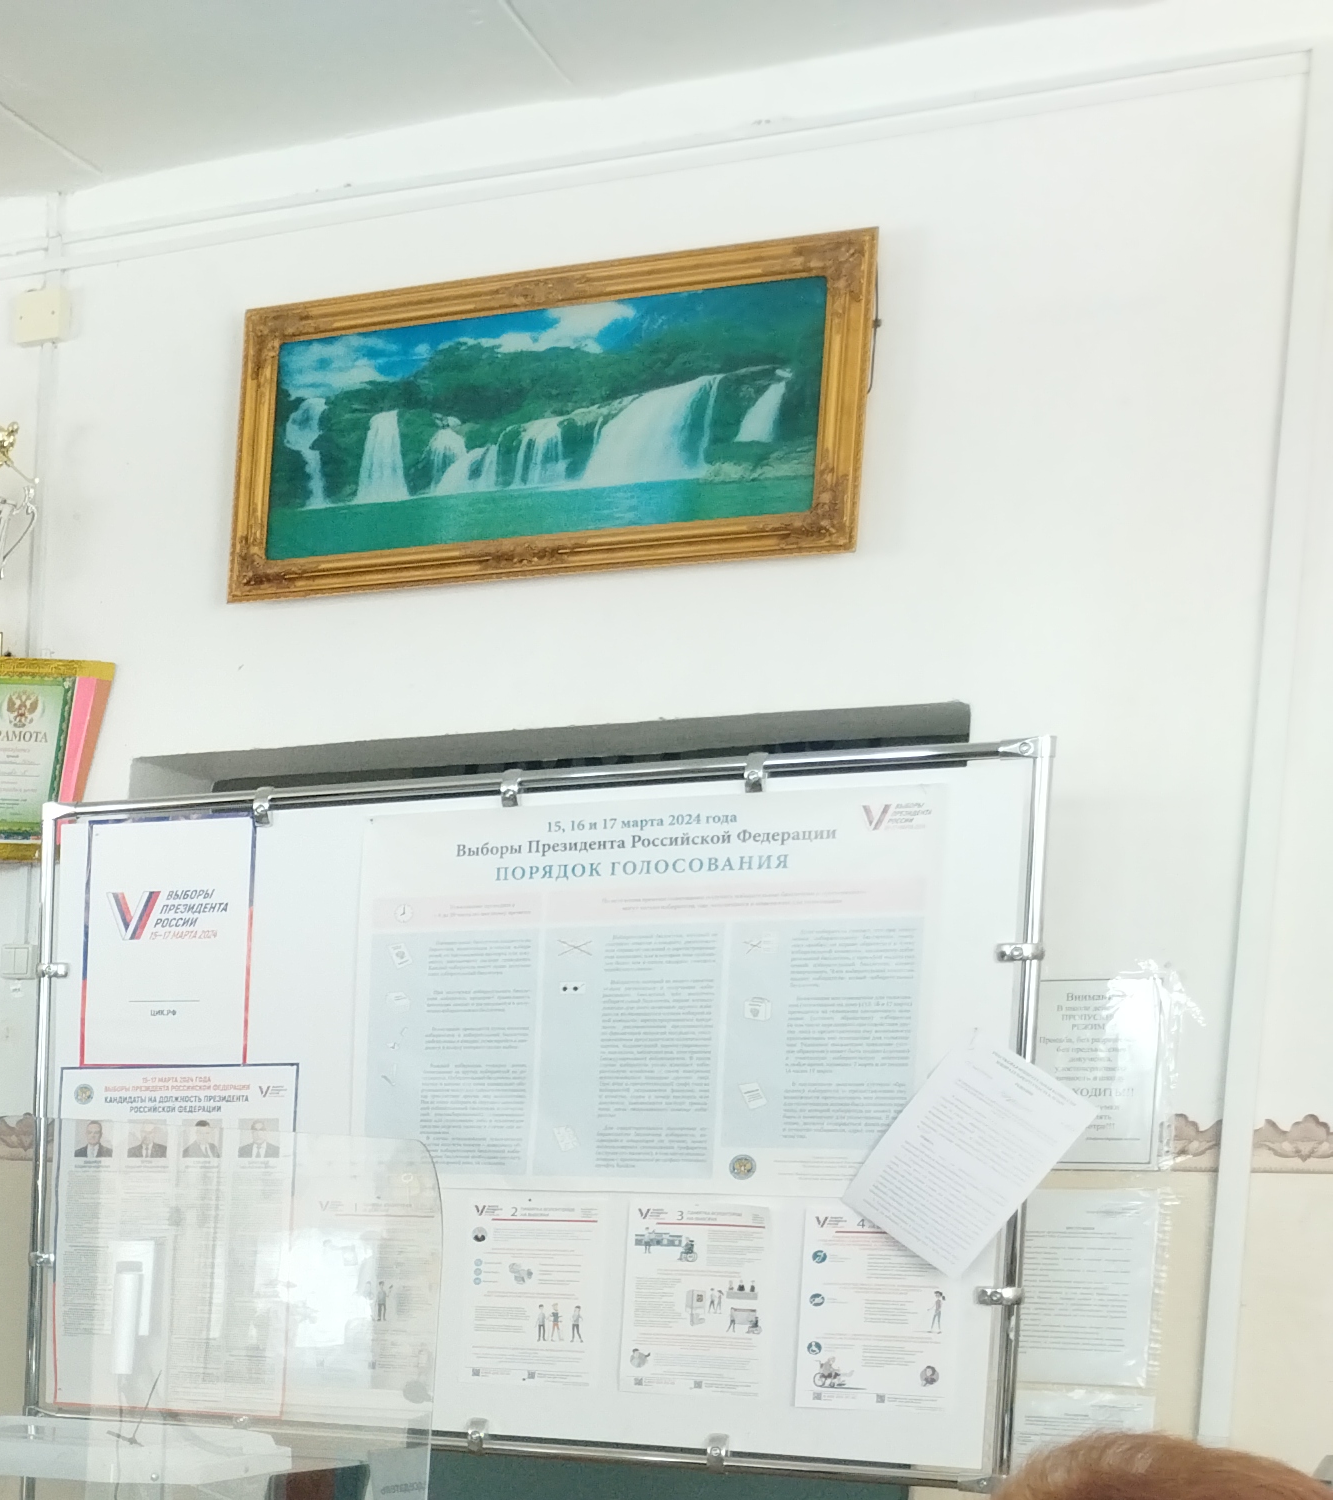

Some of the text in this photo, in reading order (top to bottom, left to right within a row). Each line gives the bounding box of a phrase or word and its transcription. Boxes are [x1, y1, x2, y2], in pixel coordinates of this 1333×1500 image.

[546, 812, 738, 834] 15, 16 и 17 марта 2024 года
[456, 826, 837, 861] Выборы Президента Российской Федерации
[494, 853, 790, 883] ПОРЯДОК ГОЛОСОВАНИЯ
[166, 888, 216, 901] ВЫБОРЫ
[159, 902, 229, 915] ПРЕЗИДЕНТА
[153, 917, 199, 929] РОССИИ
[170, 930, 198, 940] МАРТА
[198, 929, 218, 939] 2024
[1072, 1087, 1134, 1099] ХОДИТЬ!!!
[104, 1095, 147, 1105] КАНДИДАТЫ
[158, 1095, 203, 1104] ДОЛЖНОСТЬ
[203, 1094, 250, 1104] ПРЕЗИДЕНТА
[129, 1103, 222, 1114] РОССИЙСКОЙ ФЕДЕРАЦИИ
[510, 1206, 518, 1217] 2
[676, 1210, 684, 1221] 3
[856, 1218, 866, 1229] 4
